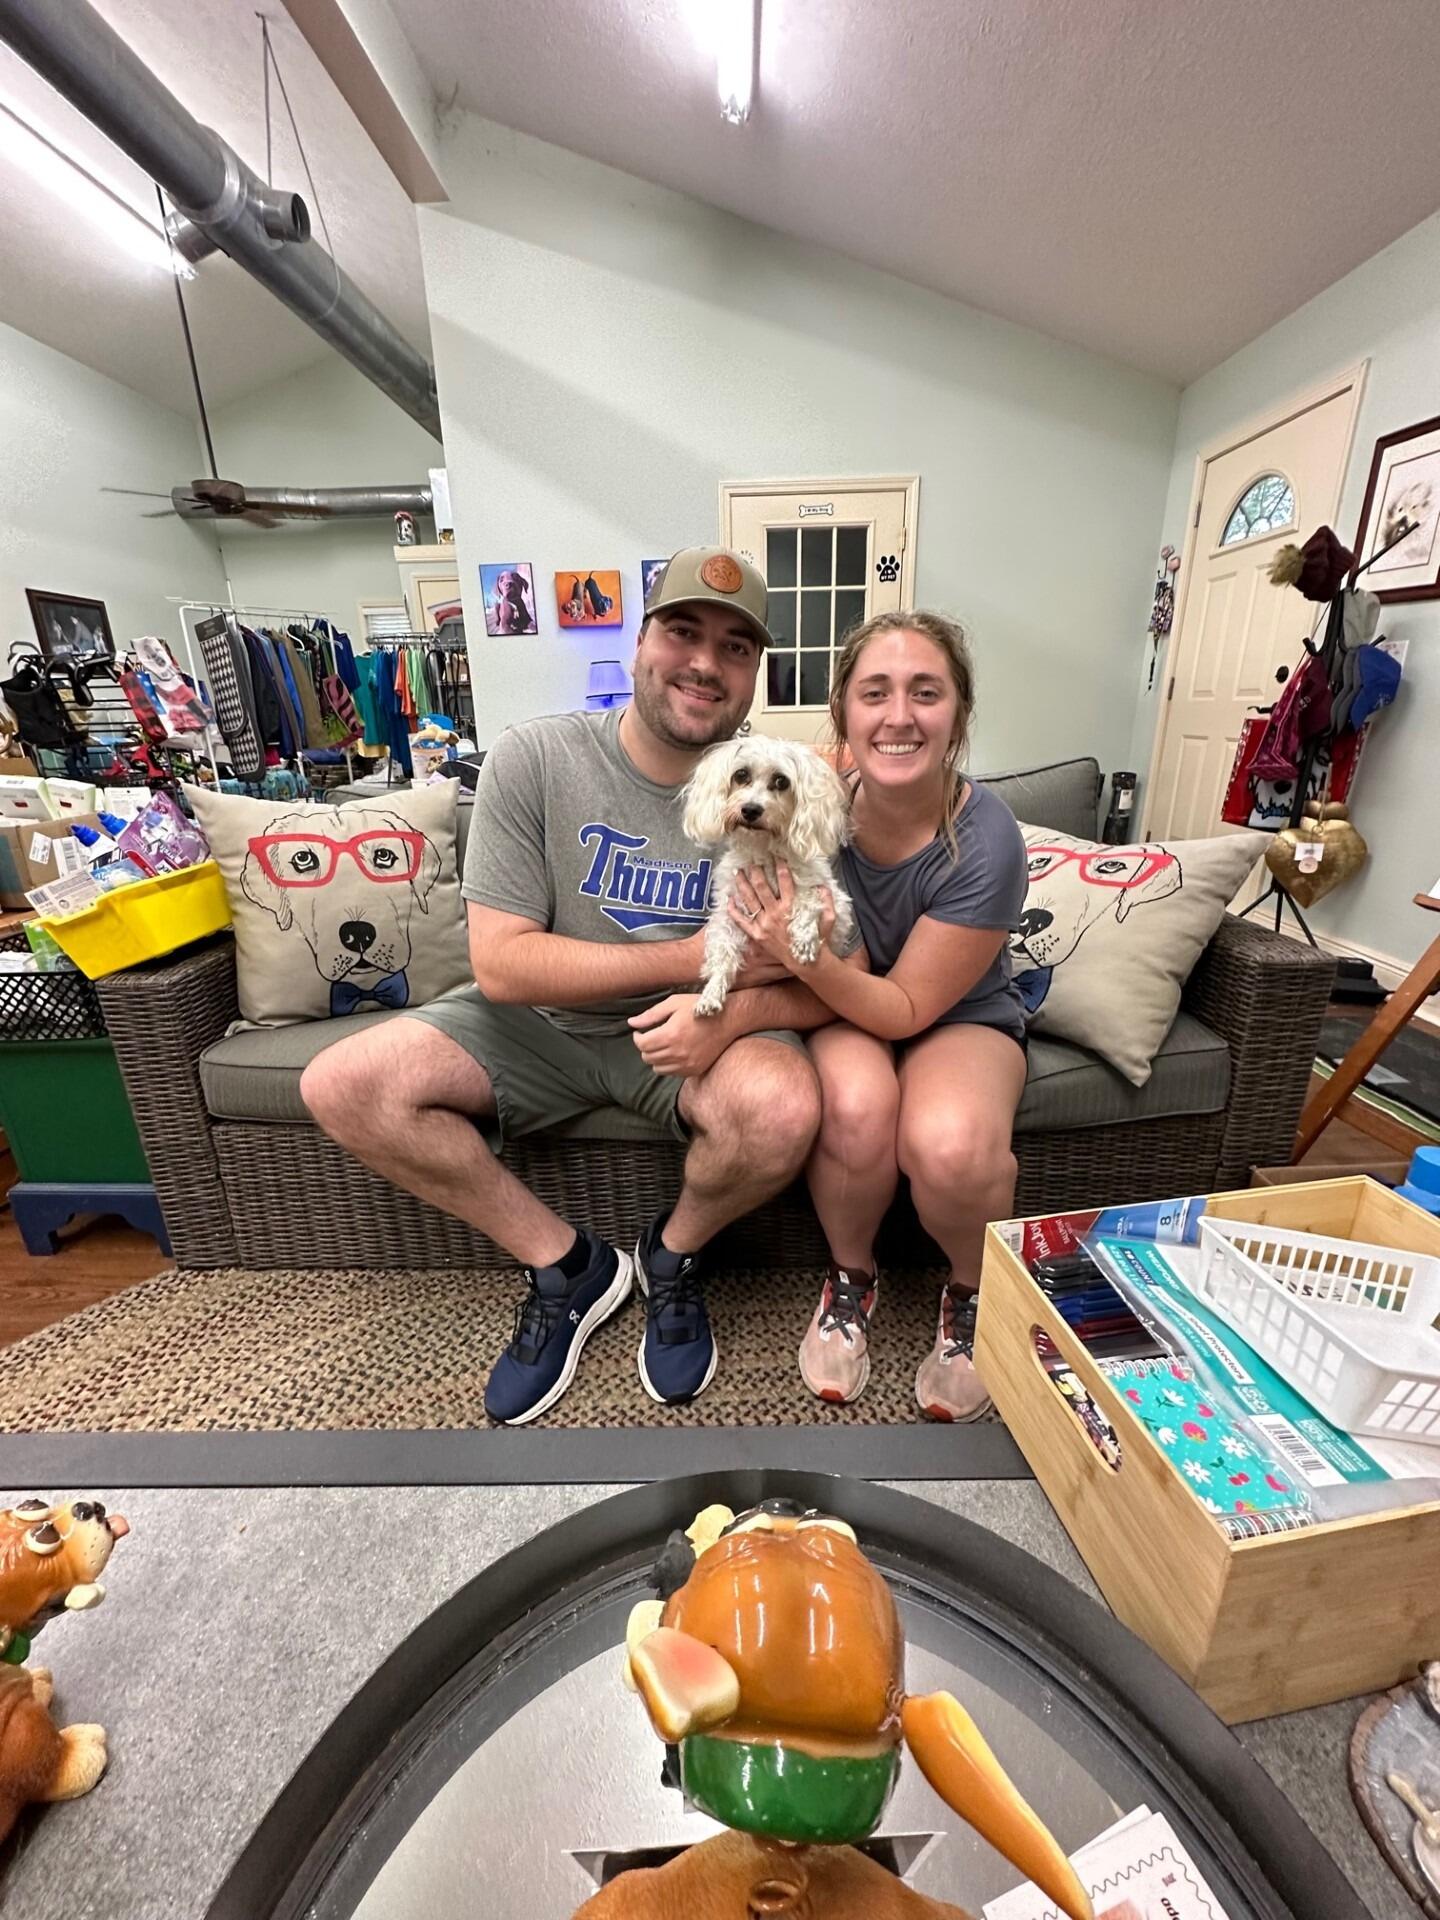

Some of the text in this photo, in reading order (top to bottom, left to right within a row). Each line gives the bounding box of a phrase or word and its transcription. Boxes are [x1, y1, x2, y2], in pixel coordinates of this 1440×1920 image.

[579, 822, 718, 911] Thund
[633, 856, 692, 869] Madison
[1029, 1222, 1051, 1259] InkJoy
[1160, 1216, 1171, 1226] 8
[1146, 1250, 1180, 1291] WEXFORD
[1207, 1335, 1244, 1379] Protectors
